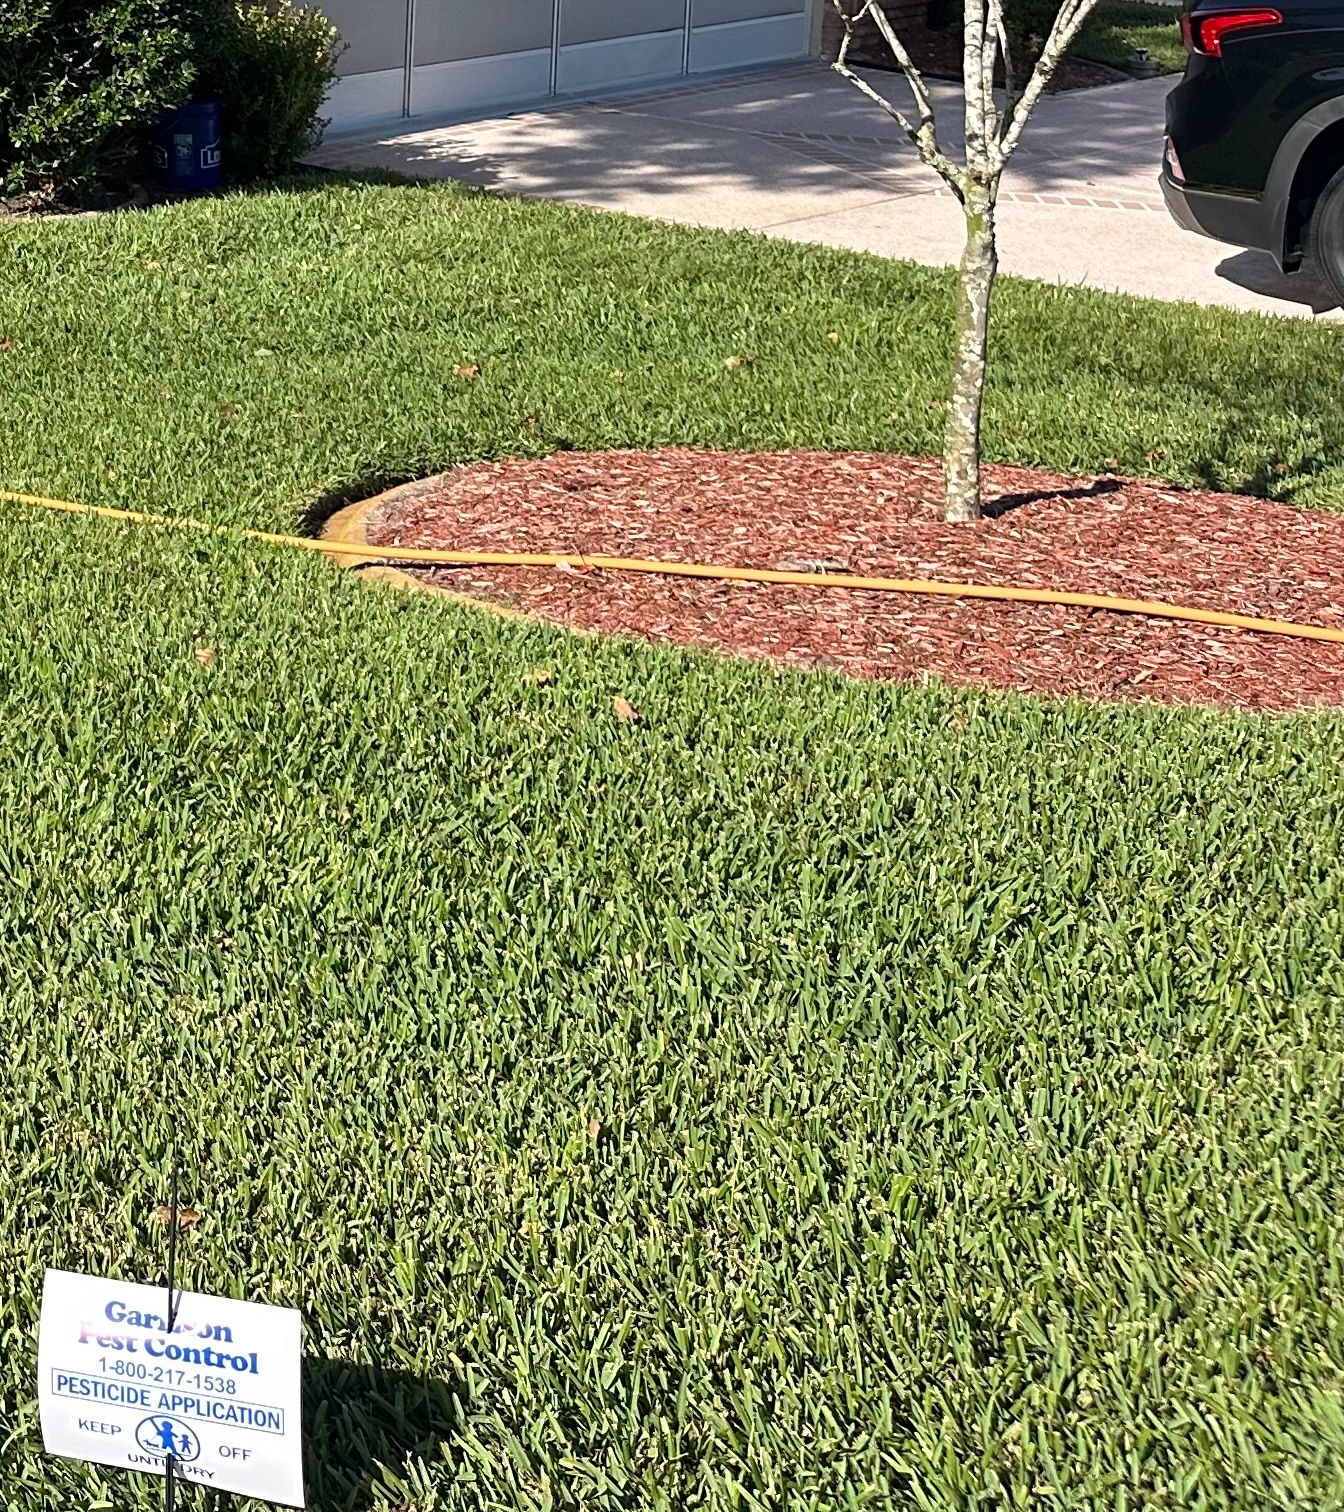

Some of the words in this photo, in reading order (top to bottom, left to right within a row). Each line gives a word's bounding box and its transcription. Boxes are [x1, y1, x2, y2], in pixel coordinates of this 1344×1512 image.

[105, 1300, 233, 1343] Garon
[99, 1357, 237, 1395] 1-800-217-1538
[144, 1338, 259, 1374] Control
[57, 1374, 152, 1407] PESTICIDE
[158, 1392, 281, 1430] APPLICATION
[78, 1418, 122, 1436] KEEP
[218, 1445, 252, 1461] OFF
[127, 1453, 167, 1467] UNTI
[179, 1463, 216, 1479] DRY
